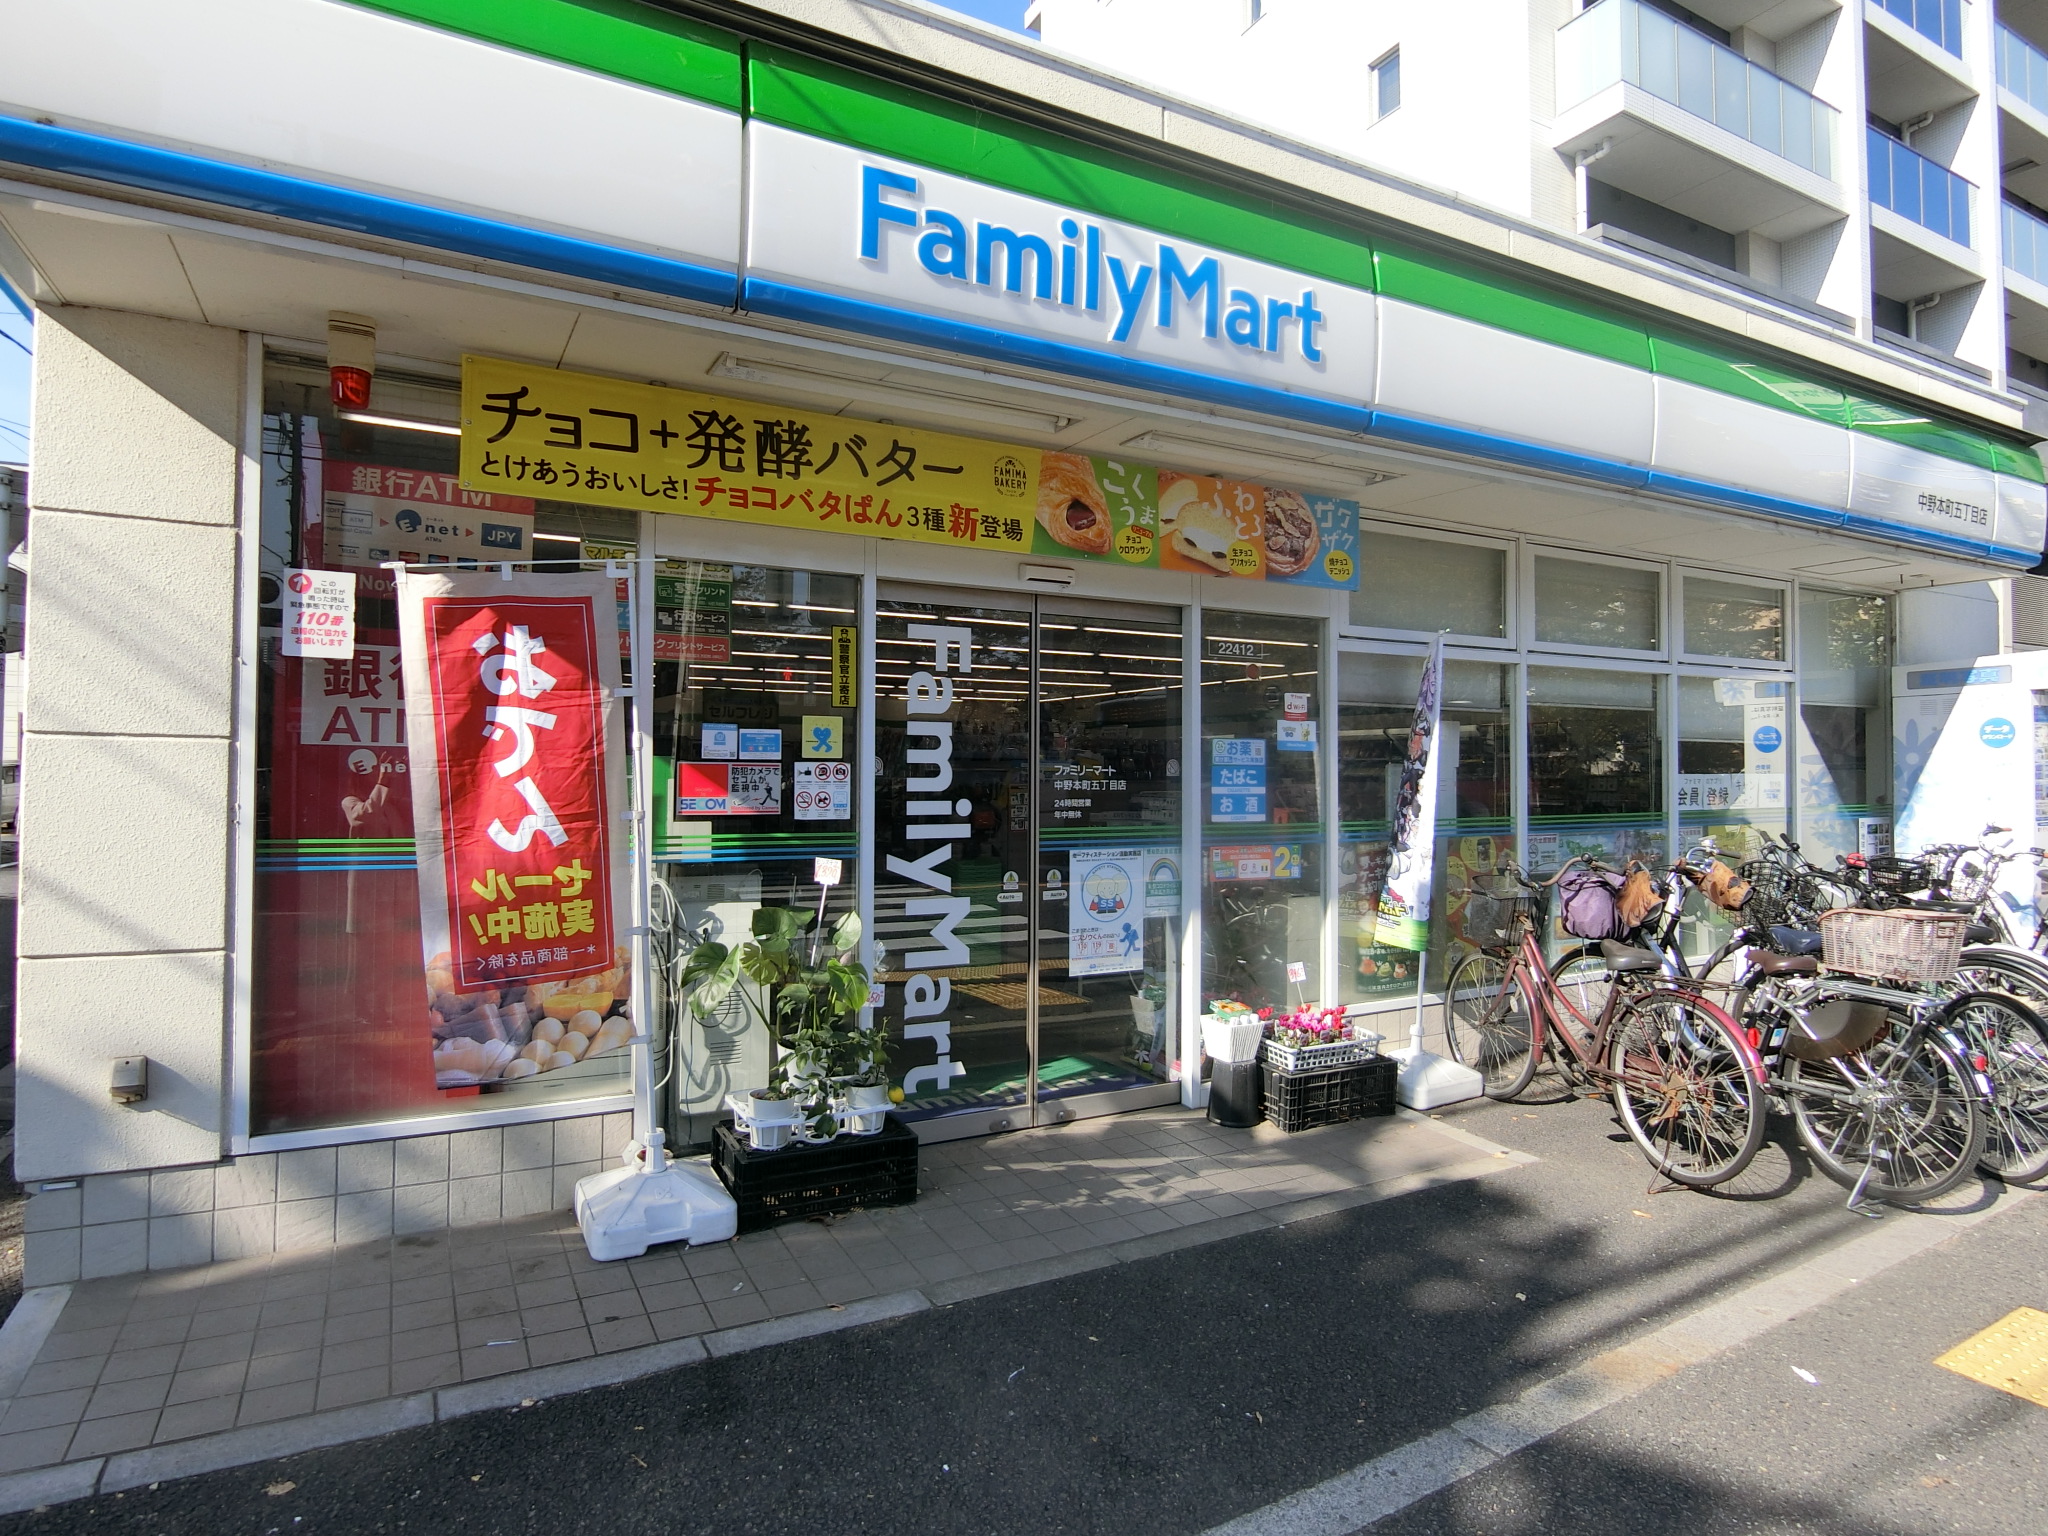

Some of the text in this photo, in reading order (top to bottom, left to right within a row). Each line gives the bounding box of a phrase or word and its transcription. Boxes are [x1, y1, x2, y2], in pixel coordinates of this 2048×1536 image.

[860, 163, 1323, 364] FamilyMart
[481, 386, 964, 487] チョコ+発酵バター
[994, 466, 1027, 480] FAMIMA
[352, 466, 492, 507] 銀行ATM
[994, 476, 1027, 490] BAKERY
[1918, 491, 1988, 526] 中野本町五丁目店
[487, 530, 517, 544] JPY
[1125, 535, 1142, 544] チョコ
[1119, 545, 1151, 555] クロワッサン
[1232, 548, 1253, 557] 生チョコ
[1230, 558, 1257, 567] ブリオッシュ
[296, 611, 344, 627] 110番
[1218, 642, 1254, 656] 22412
[838, 643, 851, 706] 警察官立寄店
[1226, 741, 1252, 756] お薬
[731, 767, 780, 776] 防犯カメラで
[1054, 765, 1117, 777] ファミリーマート
[1220, 768, 1258, 785] たばこ
[731, 775, 766, 784] セコムが
[1054, 780, 1127, 791] 中野本町五丁目店
[731, 784, 760, 793] 監視中
[680, 798, 727, 811] SECOM
[1054, 799, 1092, 808] 24時間営業
[1054, 810, 1083, 819] 年中無休
[886, 623, 973, 1096] FamilyMart
